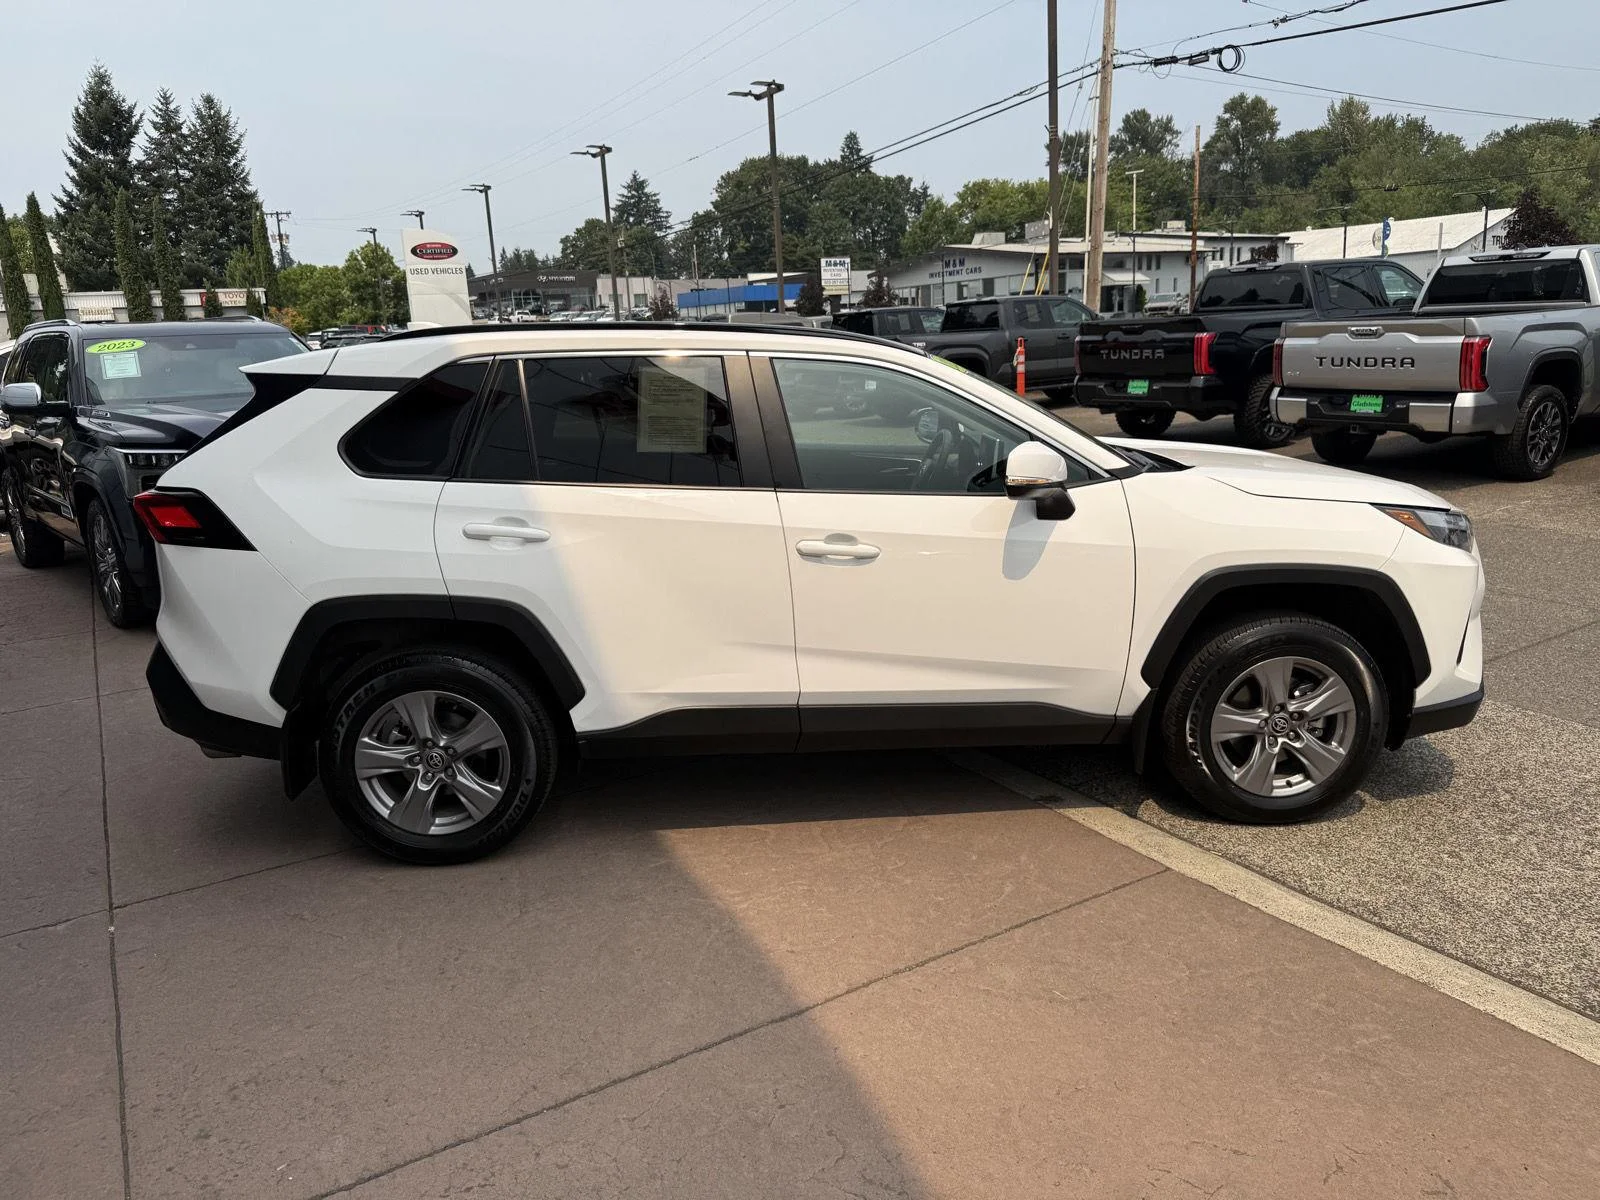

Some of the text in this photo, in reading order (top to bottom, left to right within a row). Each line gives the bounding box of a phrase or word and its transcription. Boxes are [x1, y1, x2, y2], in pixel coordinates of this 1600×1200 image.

[410, 267, 464, 275] USED VEHICLES
[965, 266, 983, 275] CARS
[223, 291, 245, 299] TOYO
[97, 341, 135, 352] 2023
[1100, 348, 1165, 360] TUNDRA
[1315, 356, 1415, 369] TUNDRA
